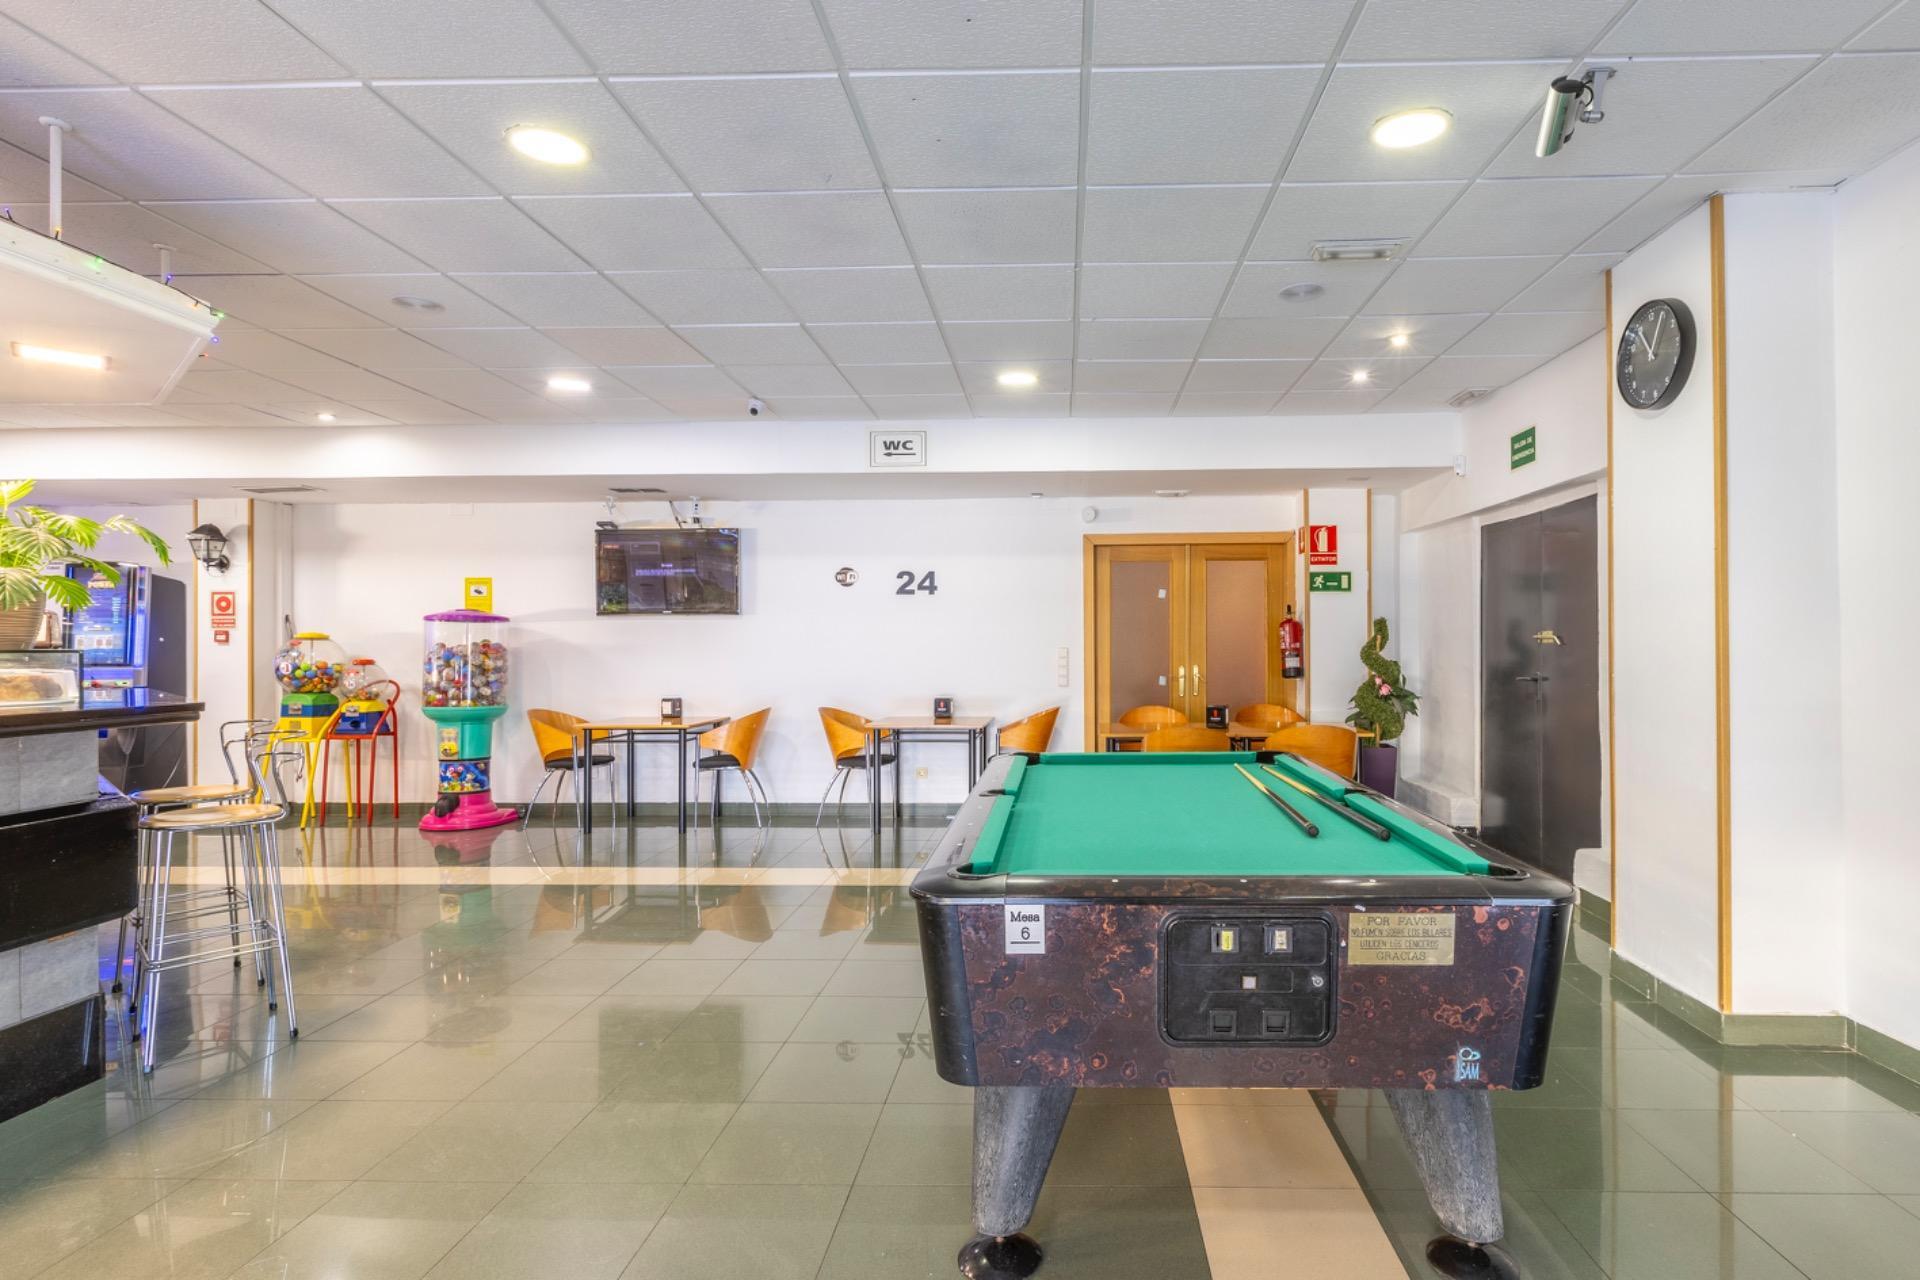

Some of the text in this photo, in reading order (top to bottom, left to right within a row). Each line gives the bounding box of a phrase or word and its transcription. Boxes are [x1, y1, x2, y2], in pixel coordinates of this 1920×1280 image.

[883, 440, 914, 451] WC
[896, 571, 938, 595] 24
[1010, 911, 1040, 922] Mesa
[1367, 916, 1437, 926] POR FAVOR
[1021, 927, 1031, 940] 6
[1376, 951, 1426, 961] GRACIAS
